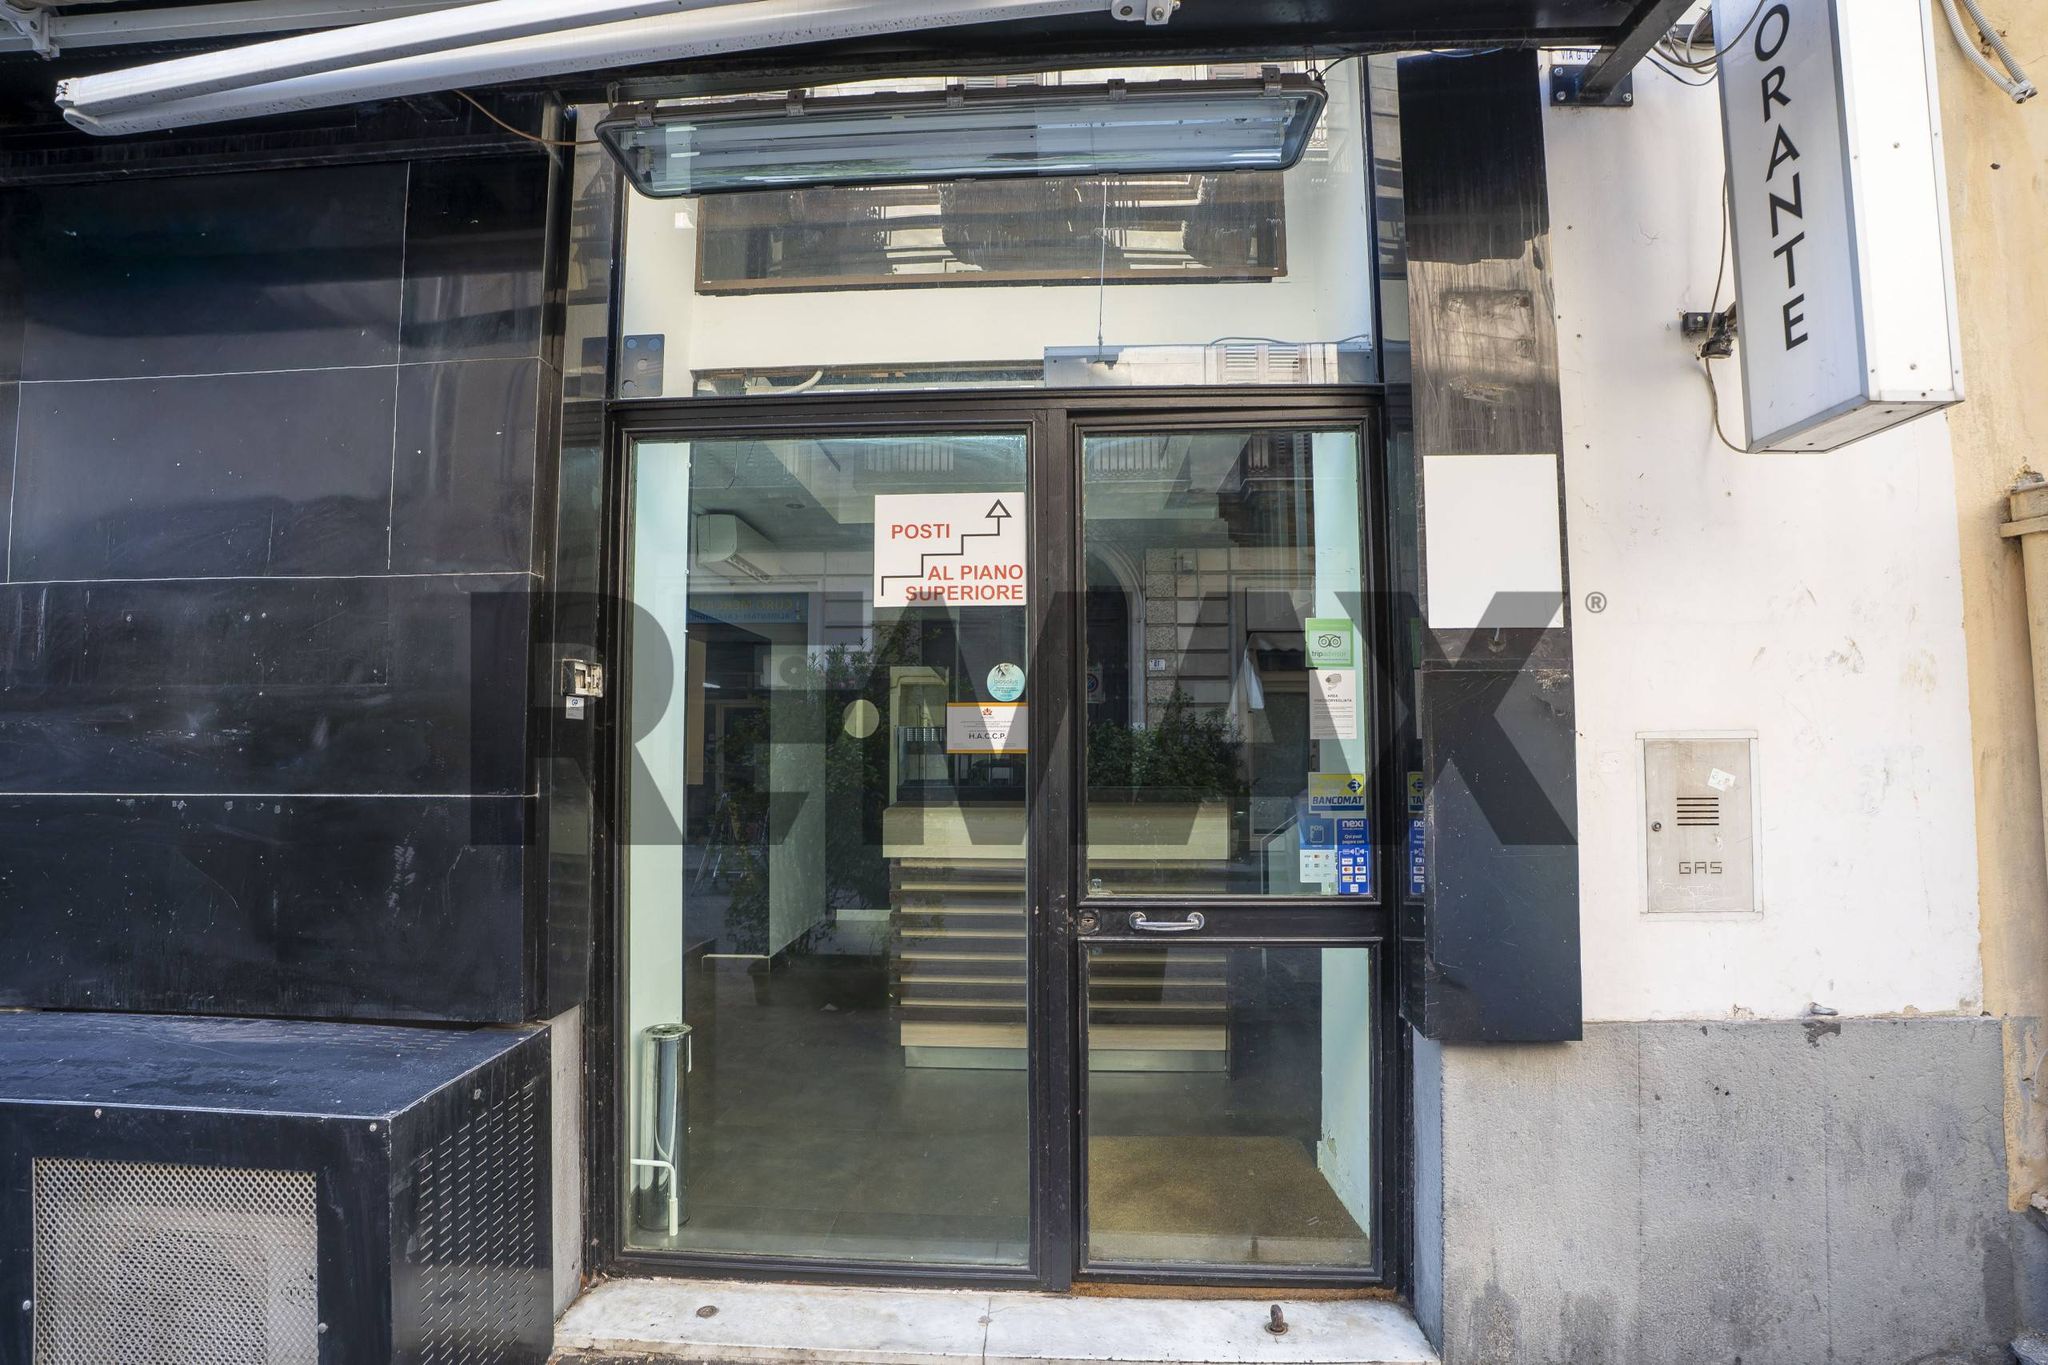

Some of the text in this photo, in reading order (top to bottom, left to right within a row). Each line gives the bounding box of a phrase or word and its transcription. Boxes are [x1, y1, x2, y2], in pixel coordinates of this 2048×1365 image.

[1754, 3, 1809, 351] ORANTE
[891, 523, 951, 539] POSTI
[927, 564, 1023, 581] AL PIANO
[905, 584, 1024, 601] SUPERIORE
[968, 732, 1008, 740] H.A.C.C.P.
[1312, 796, 1364, 805] BANCOMAT
[1342, 820, 1364, 828] nexi
[1678, 861, 1723, 875] GAS
